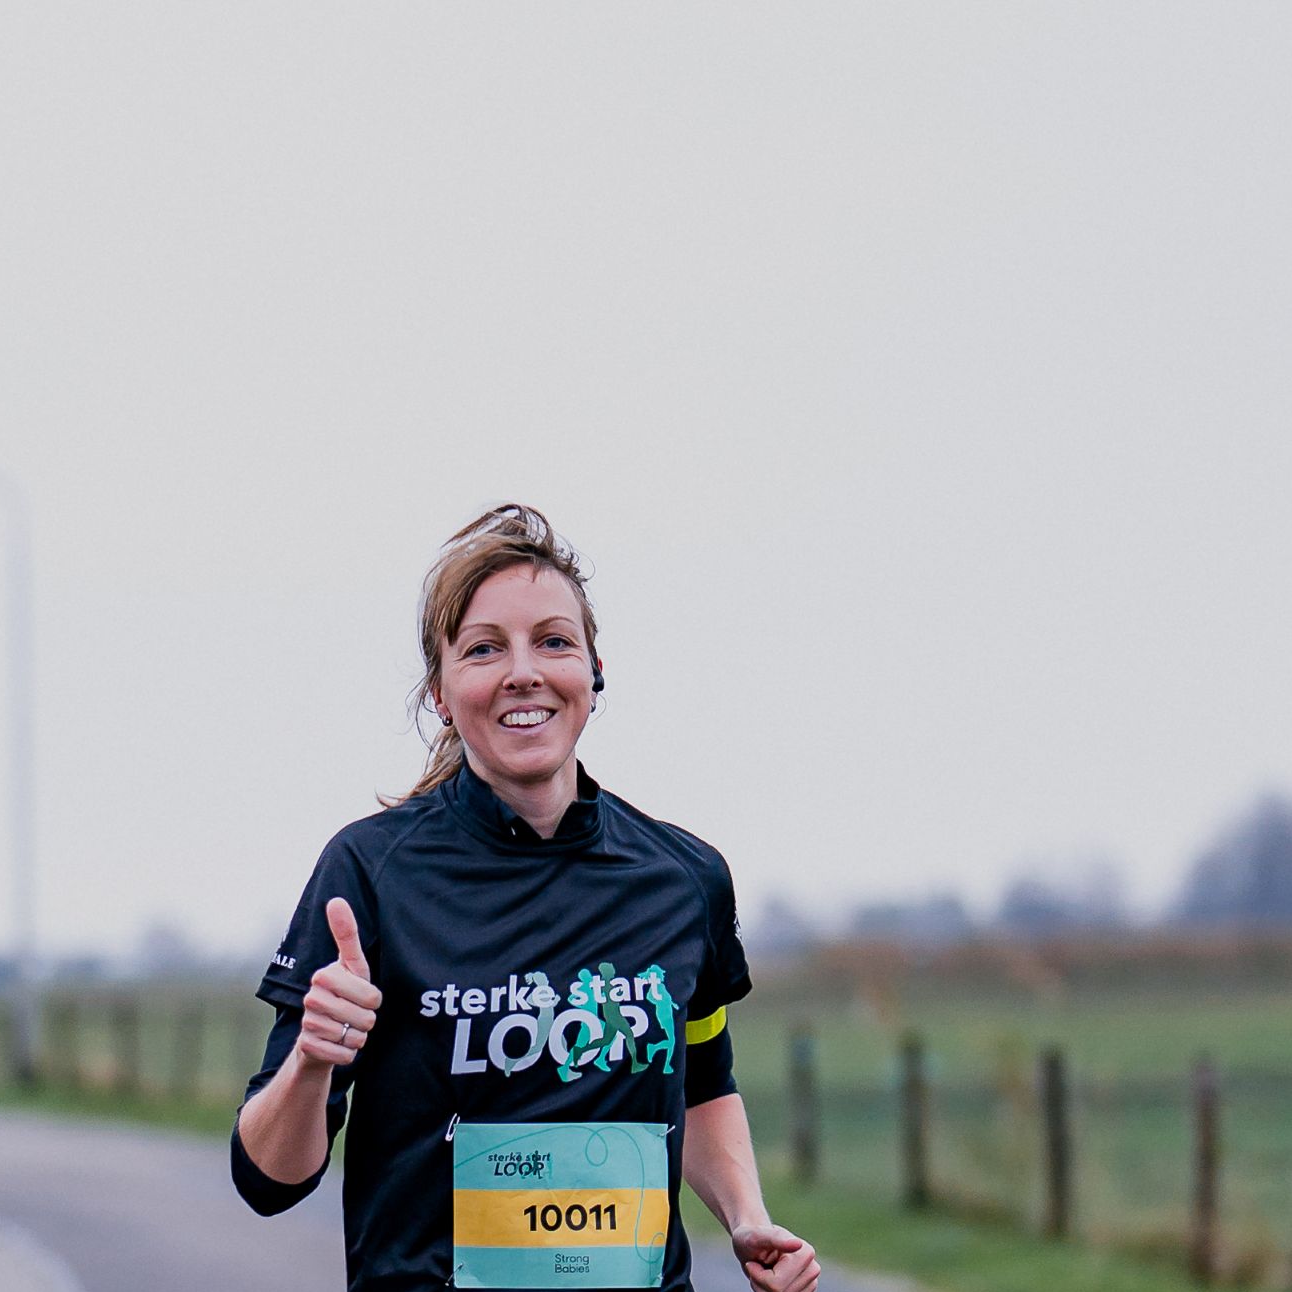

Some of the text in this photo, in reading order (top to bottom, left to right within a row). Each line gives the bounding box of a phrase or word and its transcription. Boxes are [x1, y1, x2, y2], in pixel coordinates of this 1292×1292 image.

[420, 972, 663, 1016] sterke start
[451, 1004, 649, 1074] LOOP
[488, 1151, 522, 1162] sterke
[494, 1161, 544, 1177] LOOP
[523, 1203, 617, 1232] 10011
[554, 1253, 590, 1266] Strong
[554, 1263, 590, 1274] Babies
